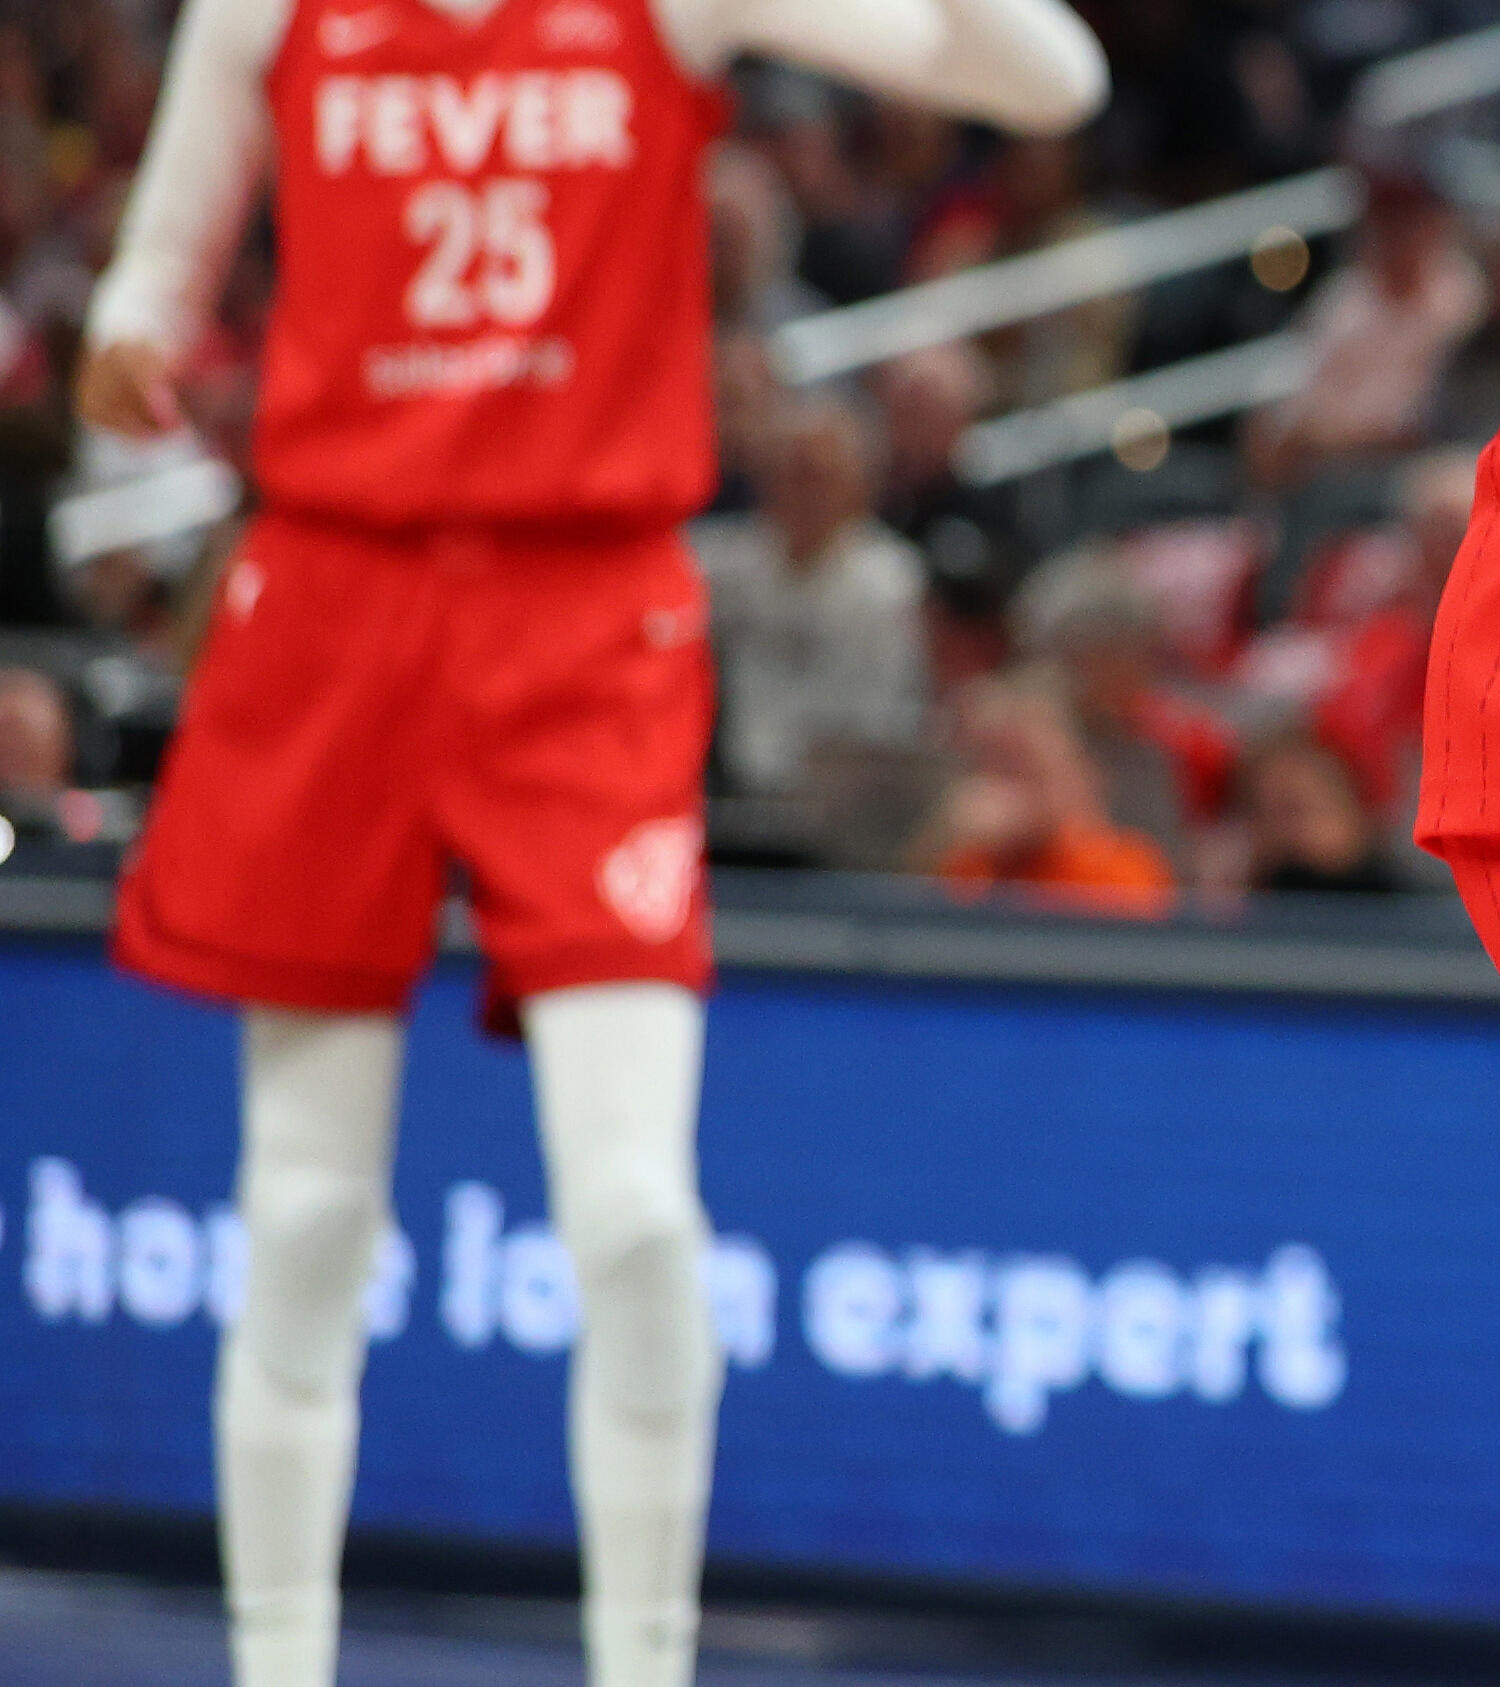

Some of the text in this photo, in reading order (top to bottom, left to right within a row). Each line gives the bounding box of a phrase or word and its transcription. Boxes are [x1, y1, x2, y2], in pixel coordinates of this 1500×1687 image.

[314, 69, 636, 177] FEVER
[406, 179, 556, 328] 25
[808, 1244, 1348, 1432] expert
